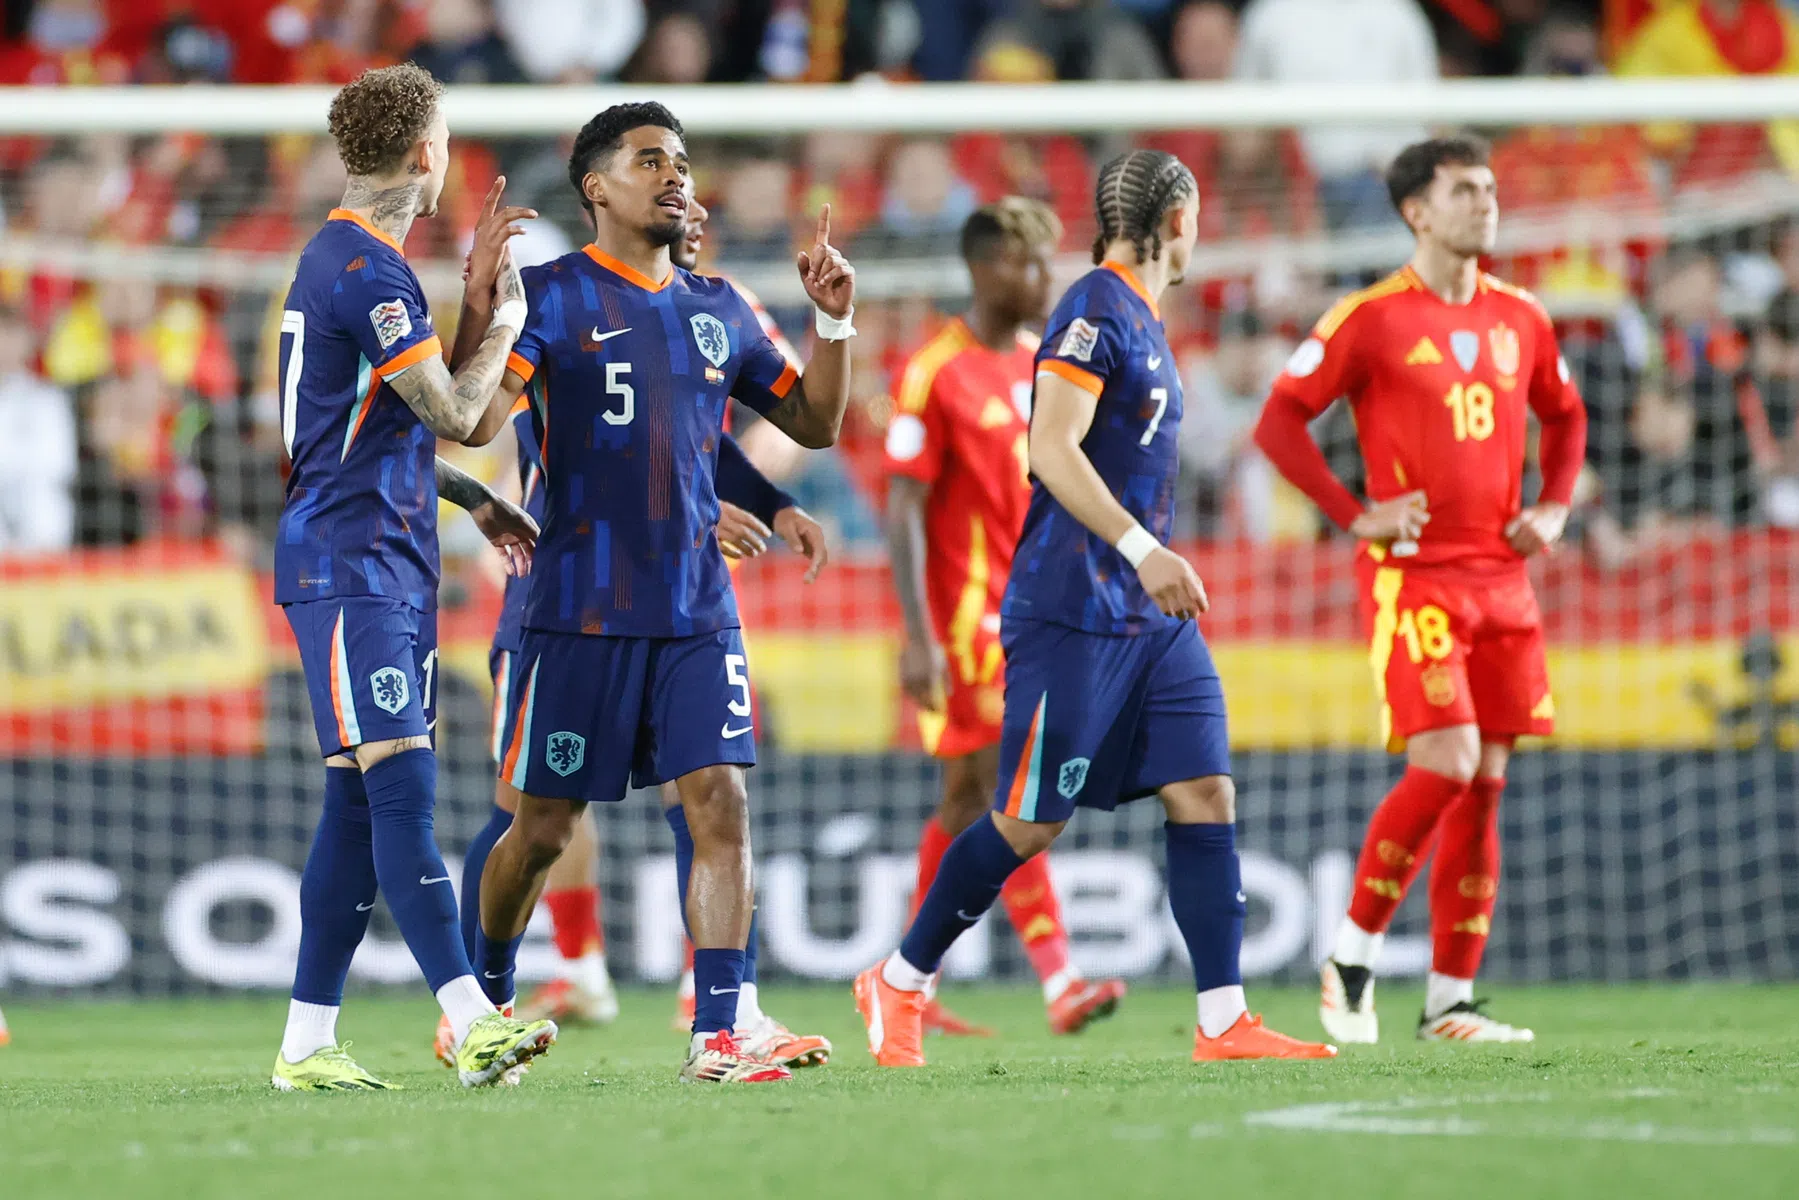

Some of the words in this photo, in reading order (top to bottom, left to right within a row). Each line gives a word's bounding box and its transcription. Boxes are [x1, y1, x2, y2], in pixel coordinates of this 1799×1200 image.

[601, 362, 634, 425] 5
[1140, 387, 1168, 446] 7
[1443, 381, 1495, 442] 18
[1397, 604, 1454, 664] 18
[421, 648, 439, 709] 1
[725, 653, 751, 716] 5
[0, 857, 132, 987] S
